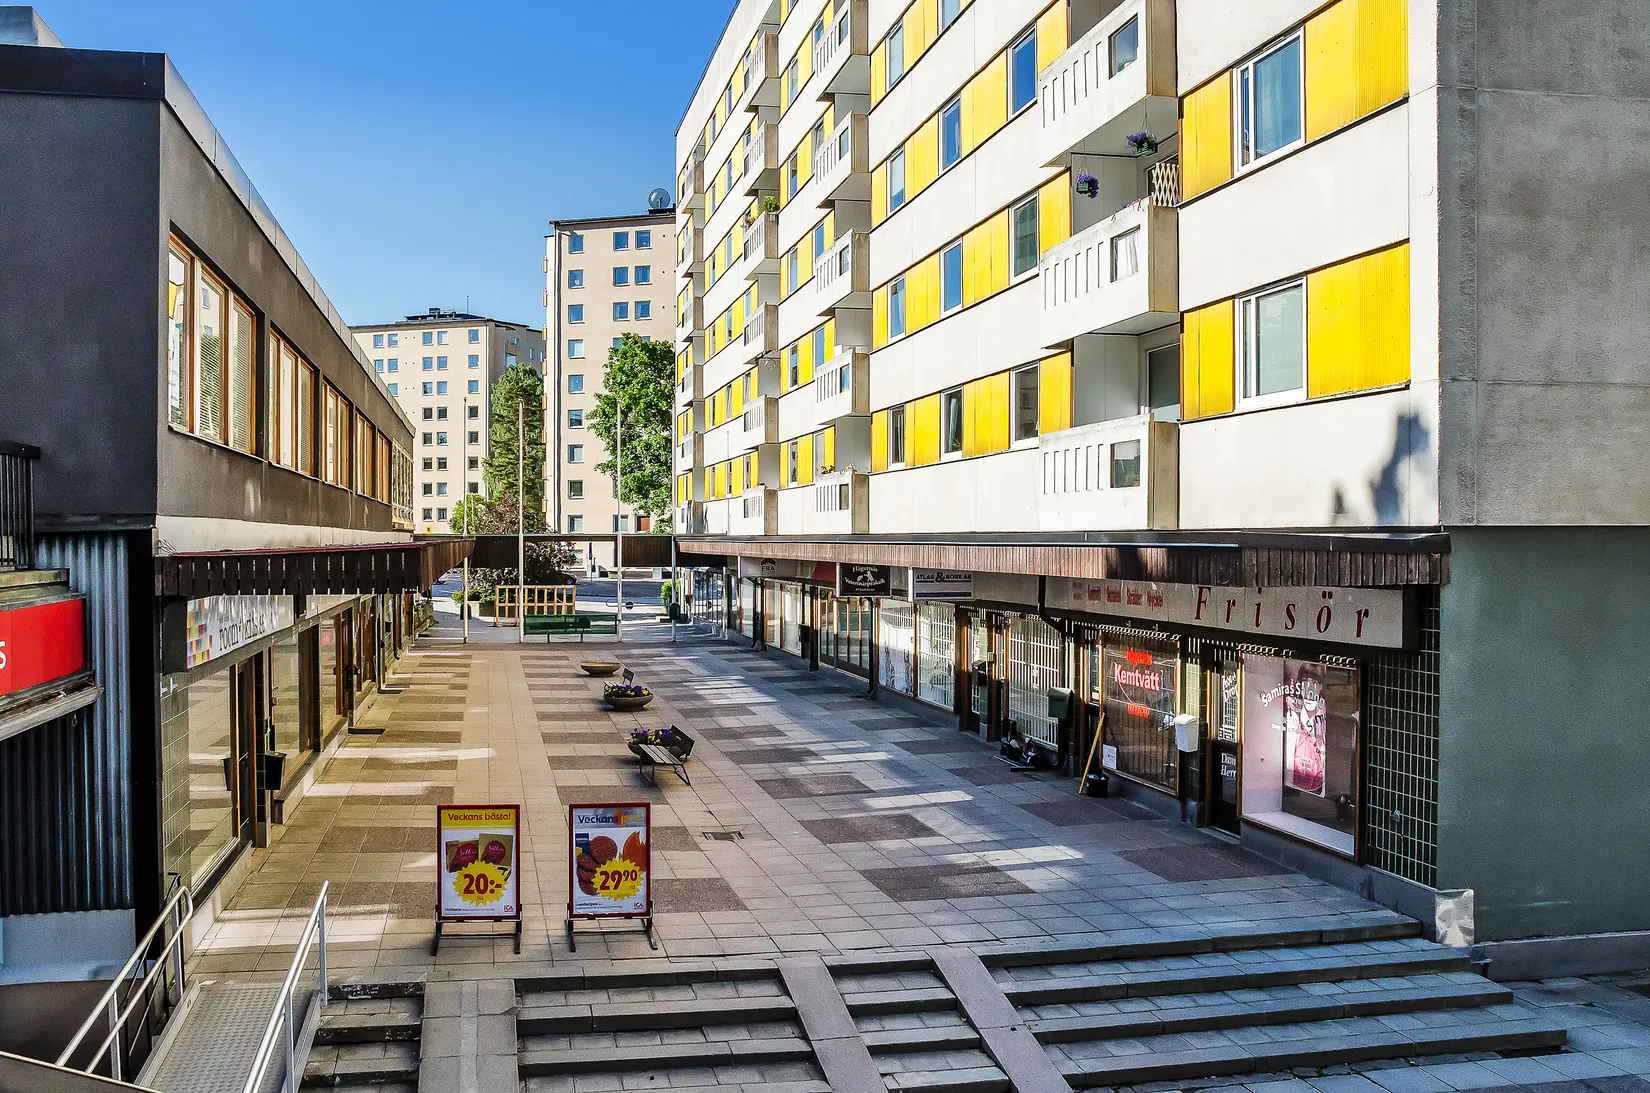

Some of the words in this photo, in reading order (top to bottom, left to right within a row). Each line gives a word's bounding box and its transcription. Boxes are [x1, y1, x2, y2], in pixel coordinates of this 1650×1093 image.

[935, 571, 946, 583] &
[1194, 585, 1370, 638] Frisör
[1114, 662, 1161, 692] Kemtvätt
[448, 812, 483, 821] Veckans
[577, 814, 619, 824] Veckans
